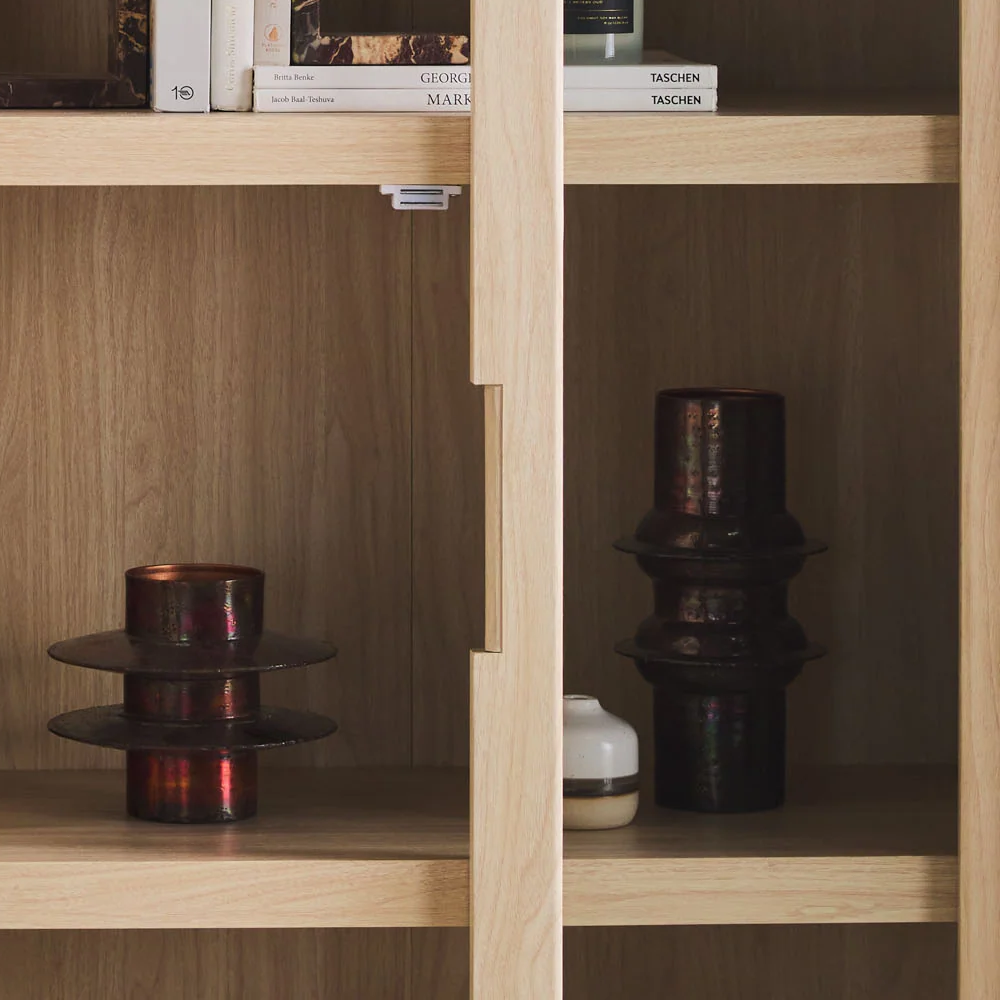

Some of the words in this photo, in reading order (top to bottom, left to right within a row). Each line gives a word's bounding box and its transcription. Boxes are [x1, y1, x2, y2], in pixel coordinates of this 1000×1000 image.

[273, 73, 292, 81] Britta
[294, 73, 315, 81] Benke
[420, 72, 472, 84] GEORGI
[650, 73, 700, 83] TASCHEN
[271, 95, 290, 103] Jacob
[291, 95, 335, 103] Baal-Teshuva
[426, 93, 472, 106] MARK
[651, 95, 701, 105] TASCHEN
